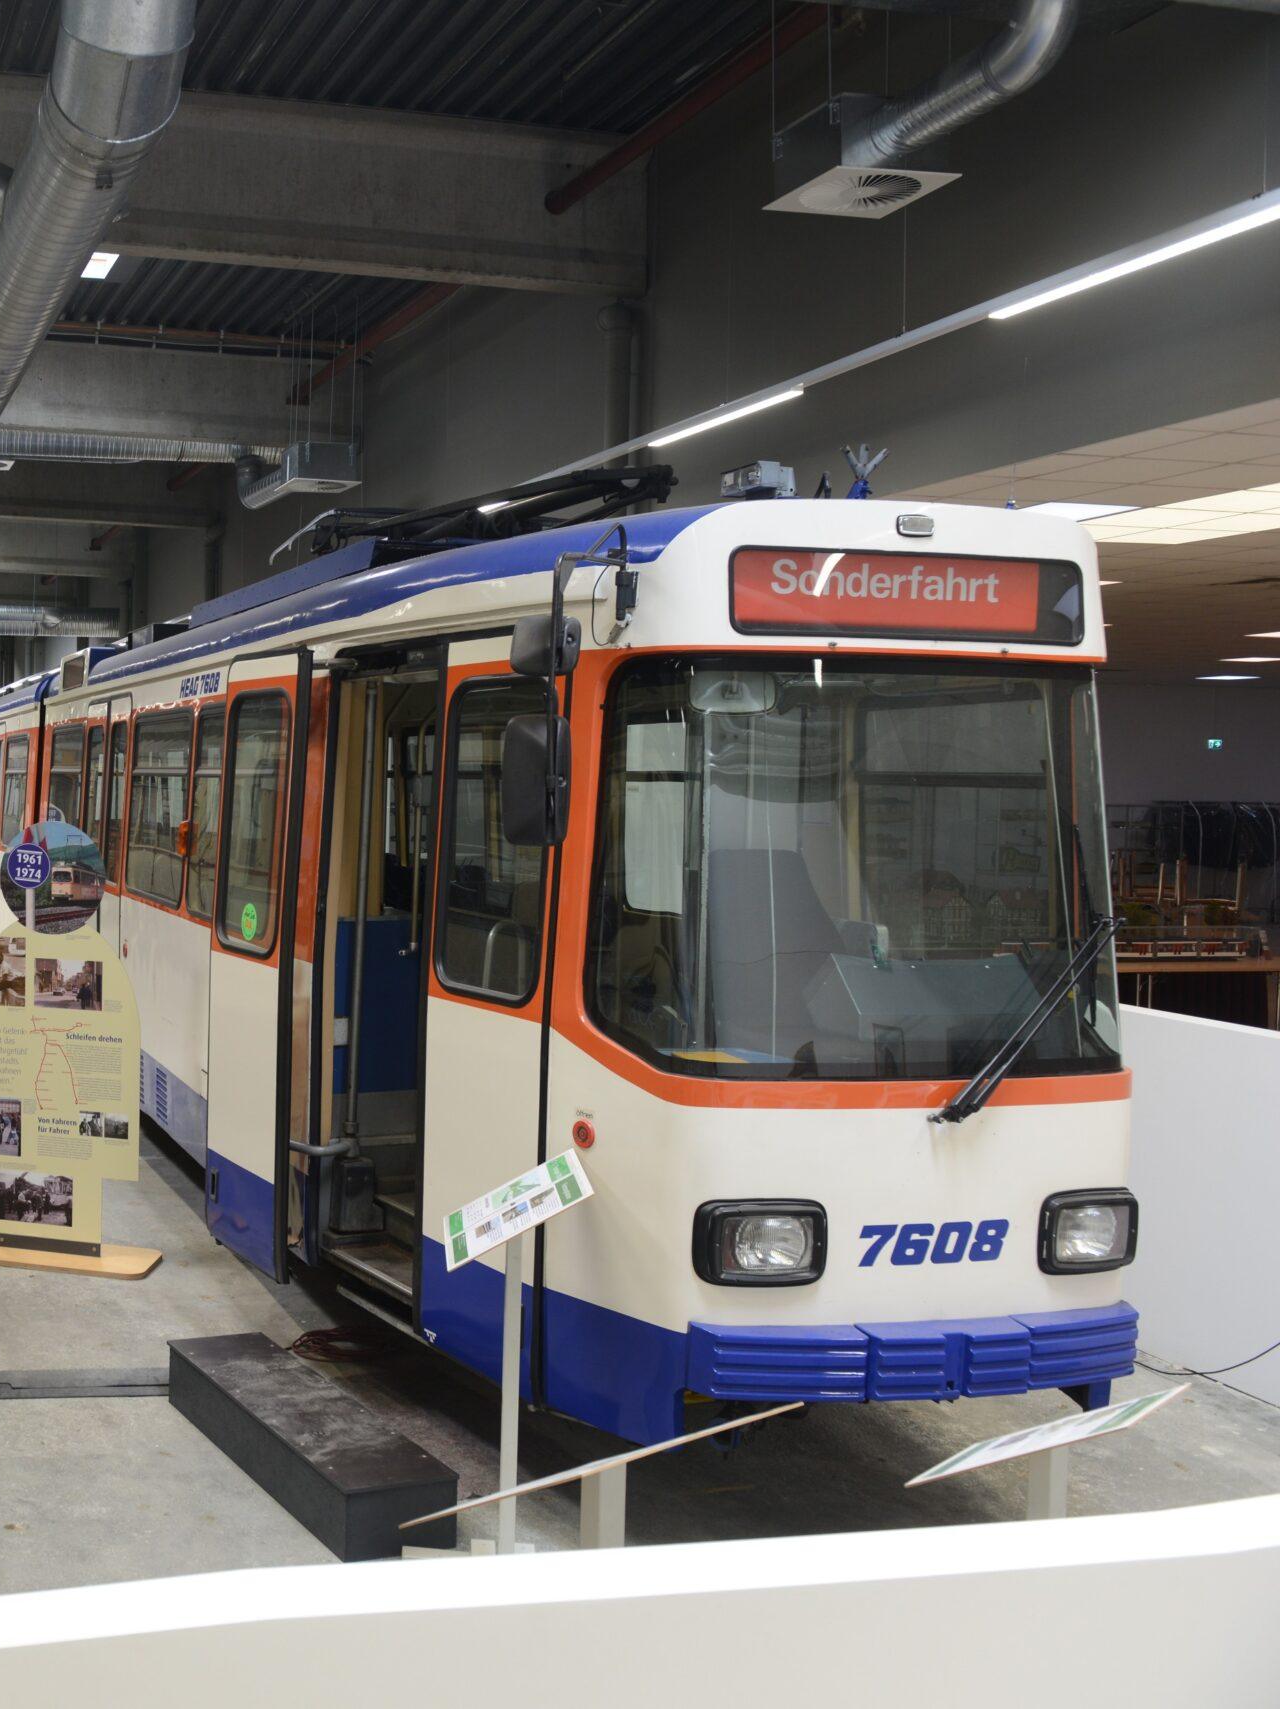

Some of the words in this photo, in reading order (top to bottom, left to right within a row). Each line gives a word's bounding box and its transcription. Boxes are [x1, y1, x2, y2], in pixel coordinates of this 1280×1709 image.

[770, 557, 1000, 604] Sonderfahrt
[179, 675, 200, 698] HEAG
[200, 671, 221, 695] 7608
[16, 853, 42, 865] 1961
[15, 867, 42, 879] 1974
[65, 1033, 97, 1042] Schleifen
[99, 1034, 123, 1044] drehen
[37, 1117, 51, 1125] Von
[51, 1117, 78, 1127] Fahrern
[49, 1126, 70, 1135] Fahrer
[857, 1218, 1010, 1268] 7608
